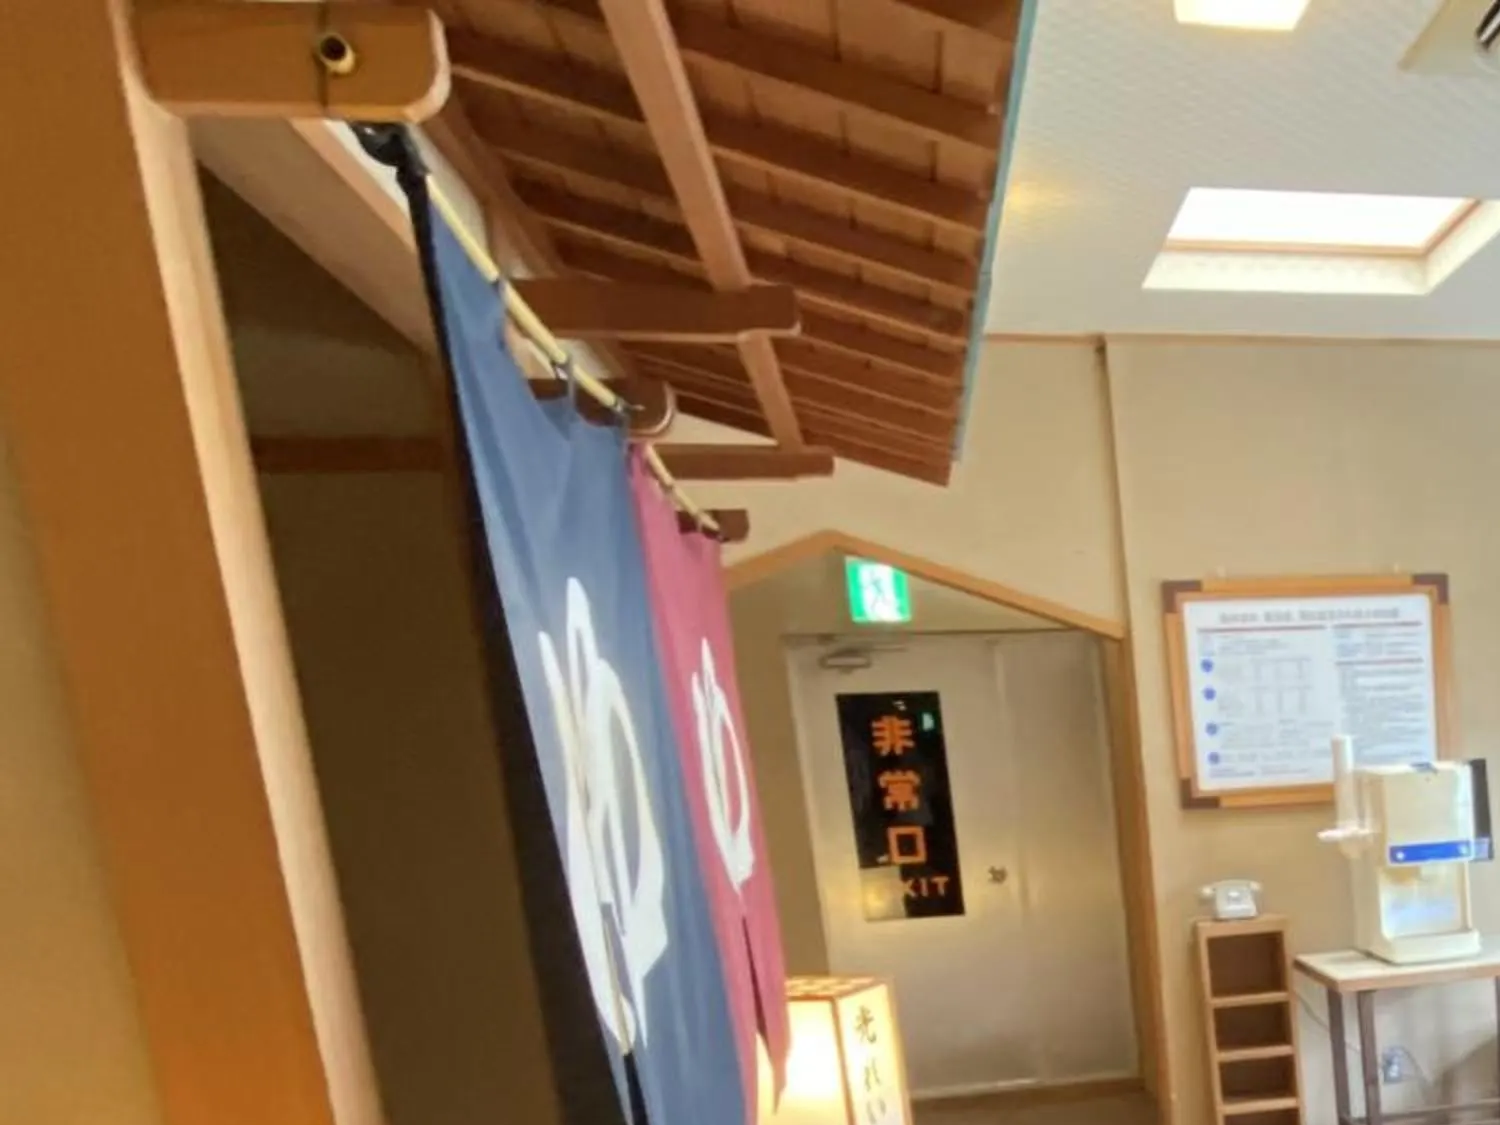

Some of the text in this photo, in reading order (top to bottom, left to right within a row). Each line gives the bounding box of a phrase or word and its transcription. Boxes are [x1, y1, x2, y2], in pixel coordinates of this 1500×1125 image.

[871, 715, 927, 863] 非常口
[889, 874, 950, 899] XIT
